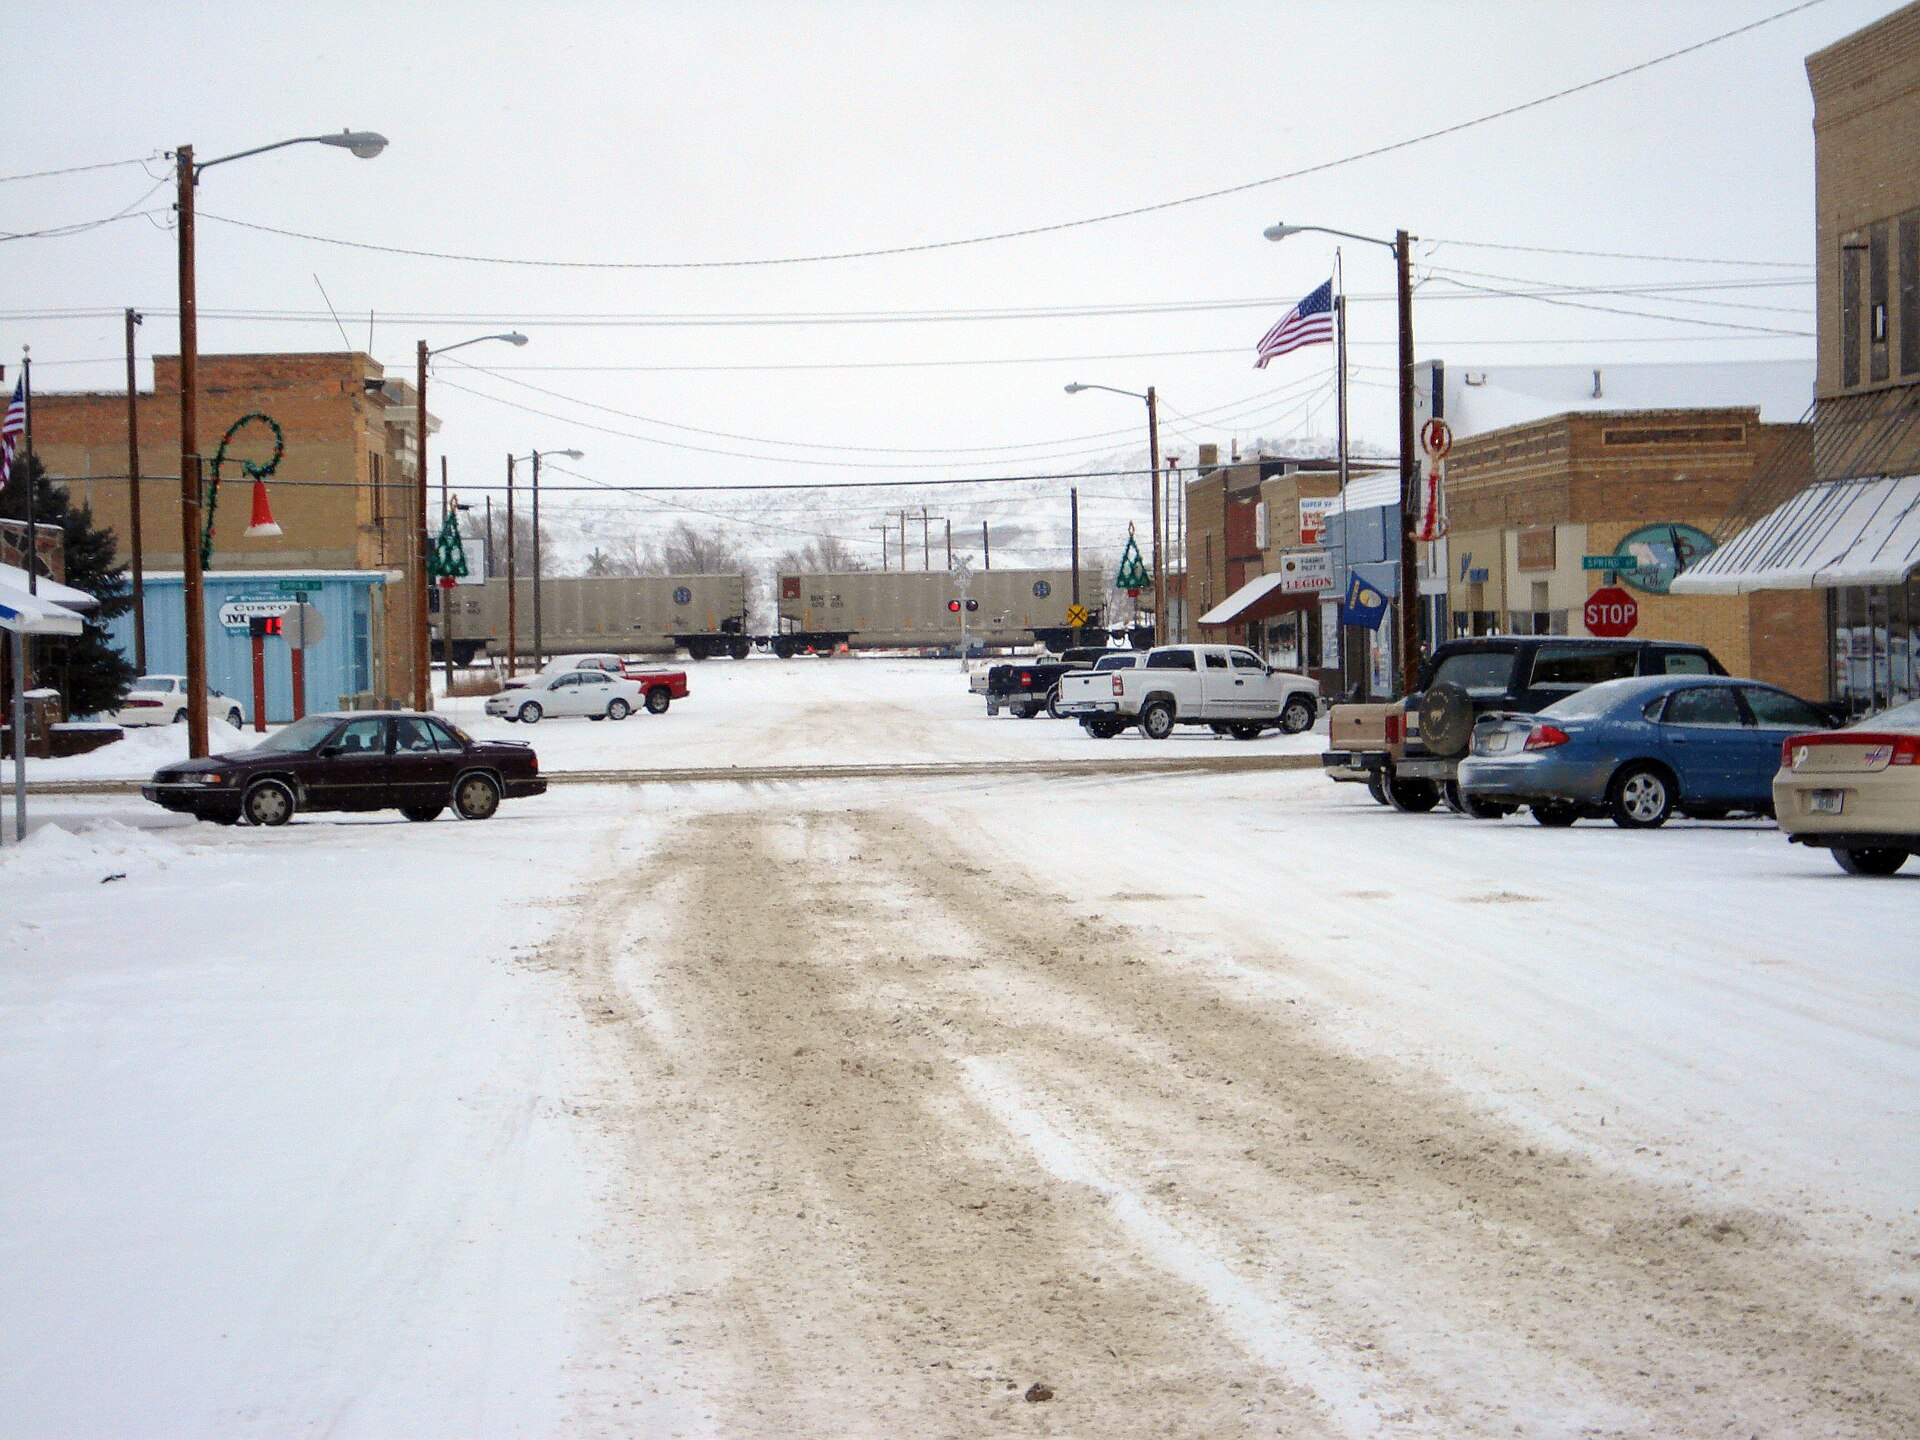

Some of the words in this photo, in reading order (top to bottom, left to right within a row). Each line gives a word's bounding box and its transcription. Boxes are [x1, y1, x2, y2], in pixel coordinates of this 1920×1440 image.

[1588, 558, 1619, 567] SPRING
[1286, 578, 1332, 588] LEGION
[234, 604, 292, 612] CUSTO
[1587, 604, 1635, 625] STOP
